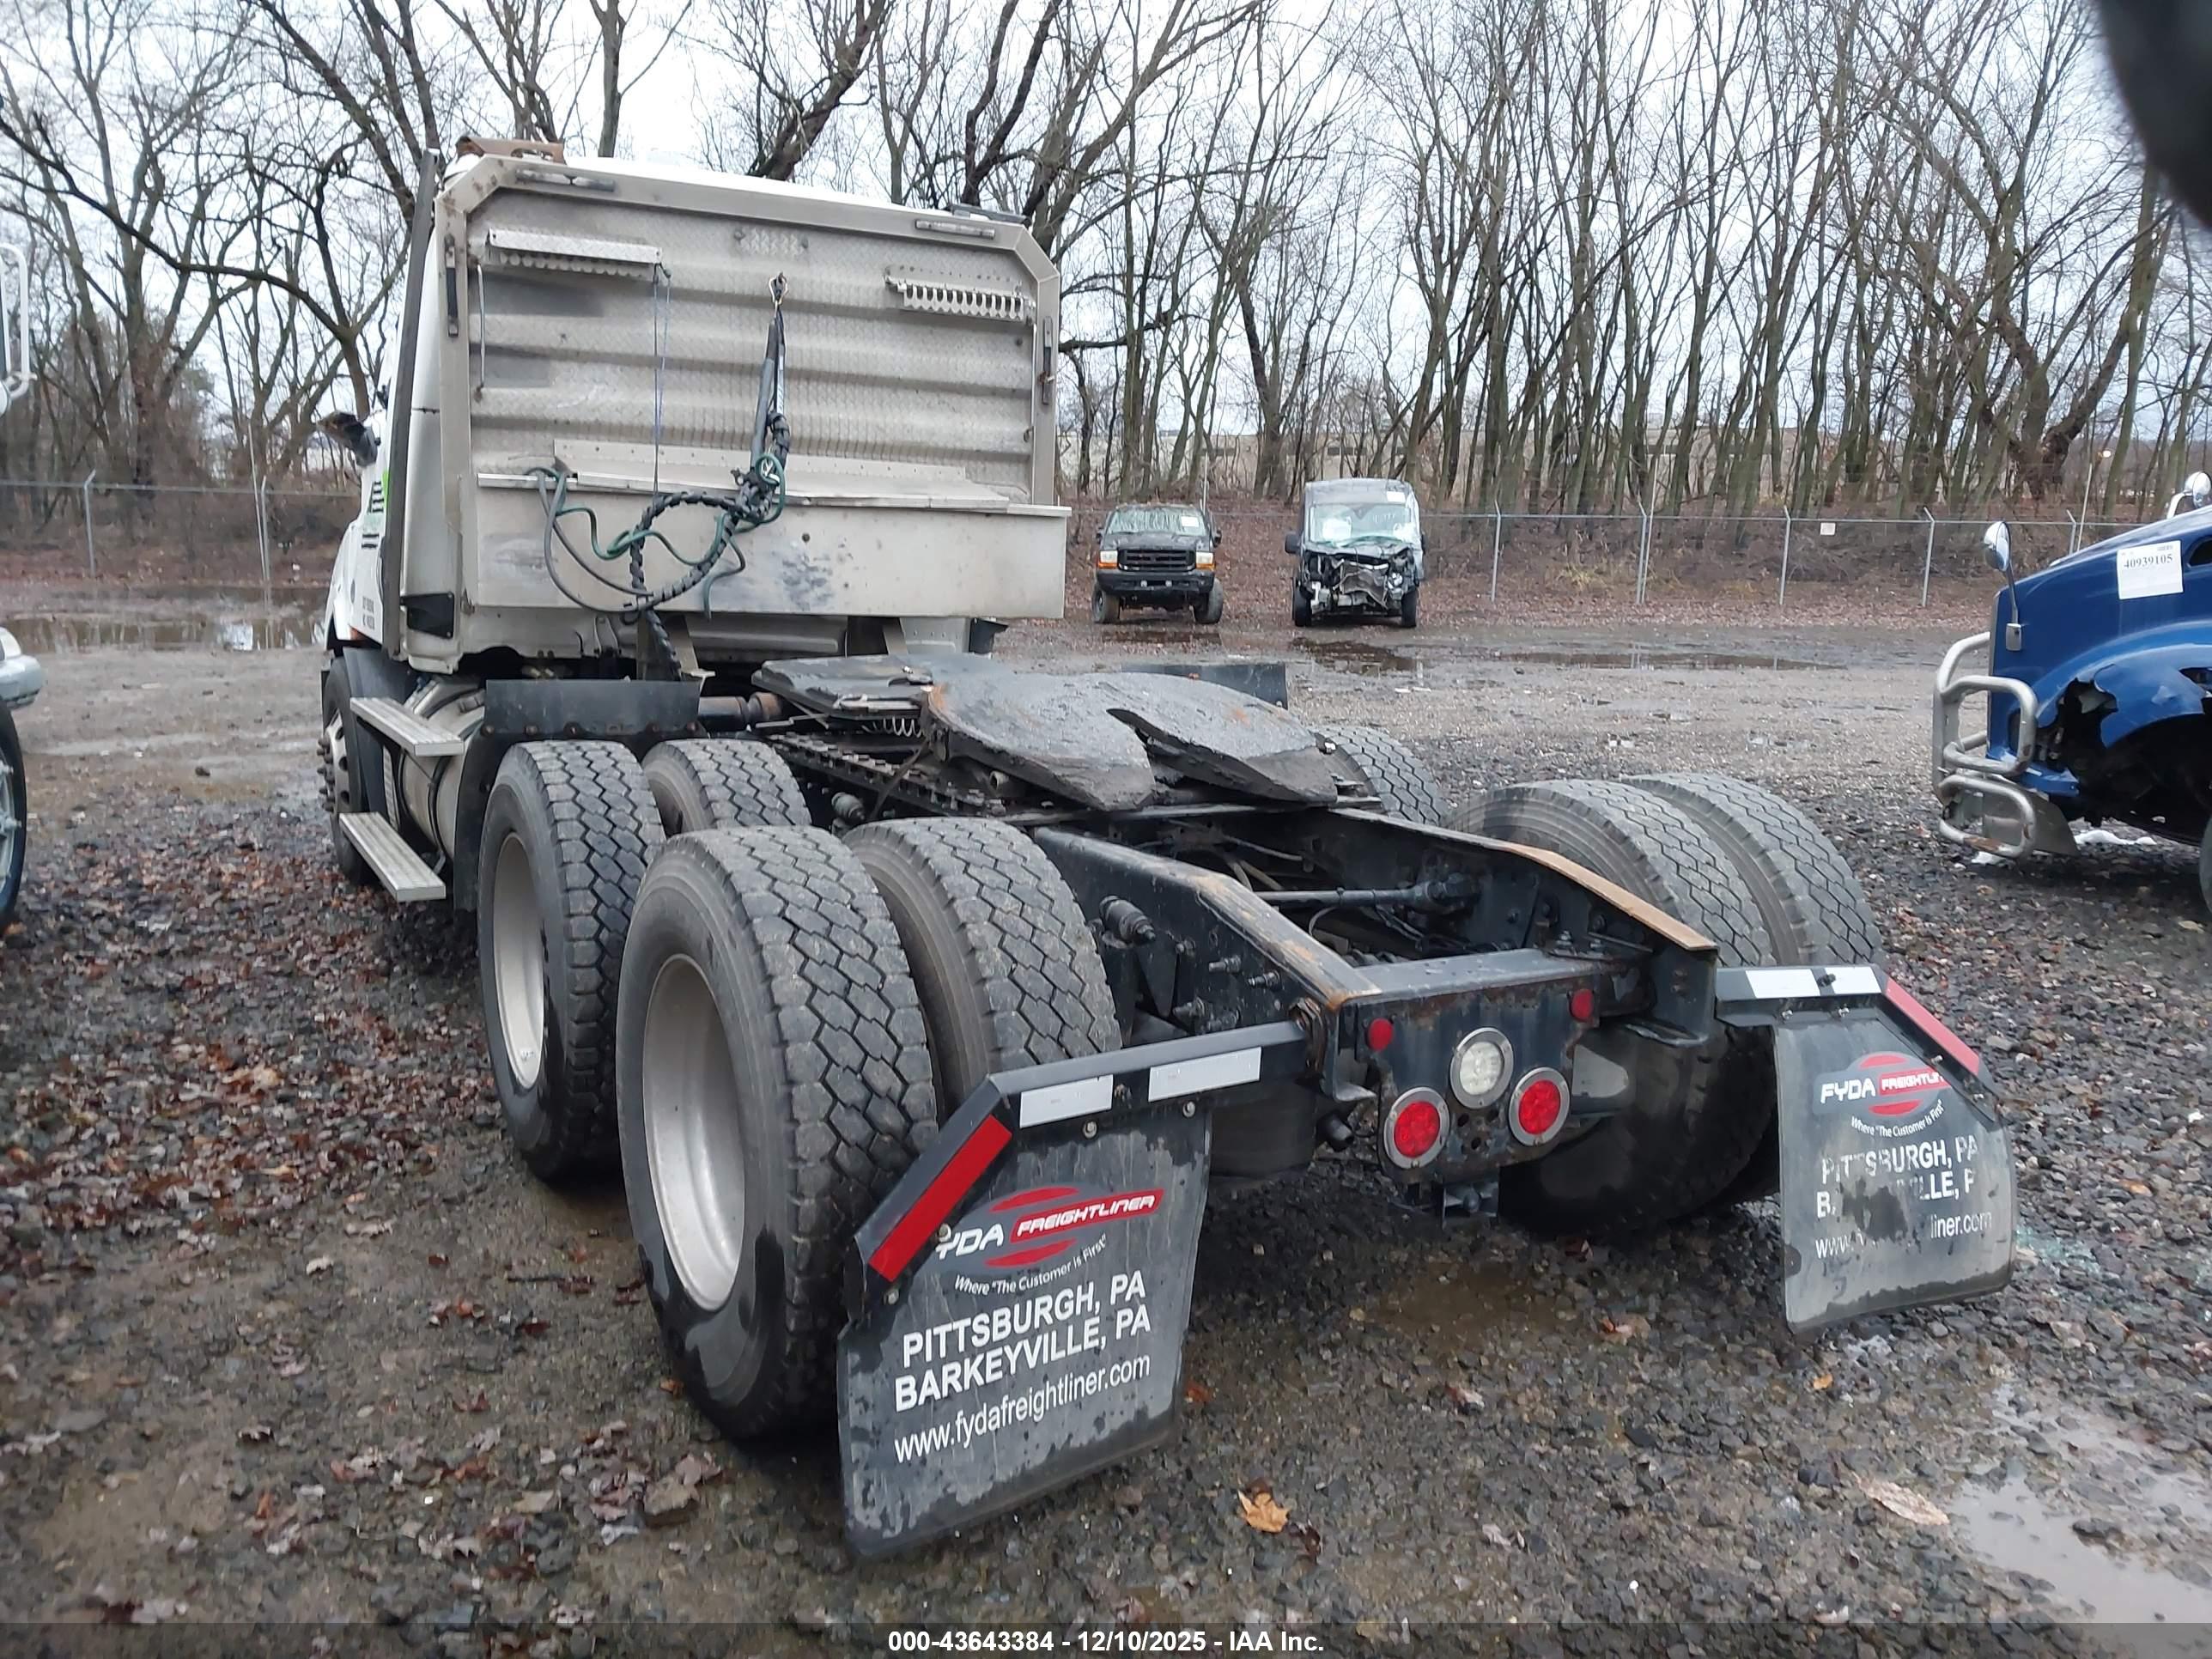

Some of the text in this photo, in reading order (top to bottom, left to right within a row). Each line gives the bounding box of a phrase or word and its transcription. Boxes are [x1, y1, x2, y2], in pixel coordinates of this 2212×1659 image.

[2124, 553, 2173, 568] 40939105
[1820, 1078, 1876, 1103] FYDA
[1851, 1115, 1875, 1135] Where
[1893, 1121, 1926, 1138] Customer
[1955, 1134, 1978, 1163] PA
[1017, 1194, 1156, 1237] FREIGHTLINER
[935, 1223, 1004, 1261] YDA
[955, 1273, 989, 1295] Where
[1018, 1262, 1072, 1291] Customer
[902, 1270, 1146, 1368] PITTSBURGH, PA
[895, 1304, 1152, 1413] BARKEYVILLE, PA
[894, 1354, 1151, 1463] www.fydafreightliner.com
